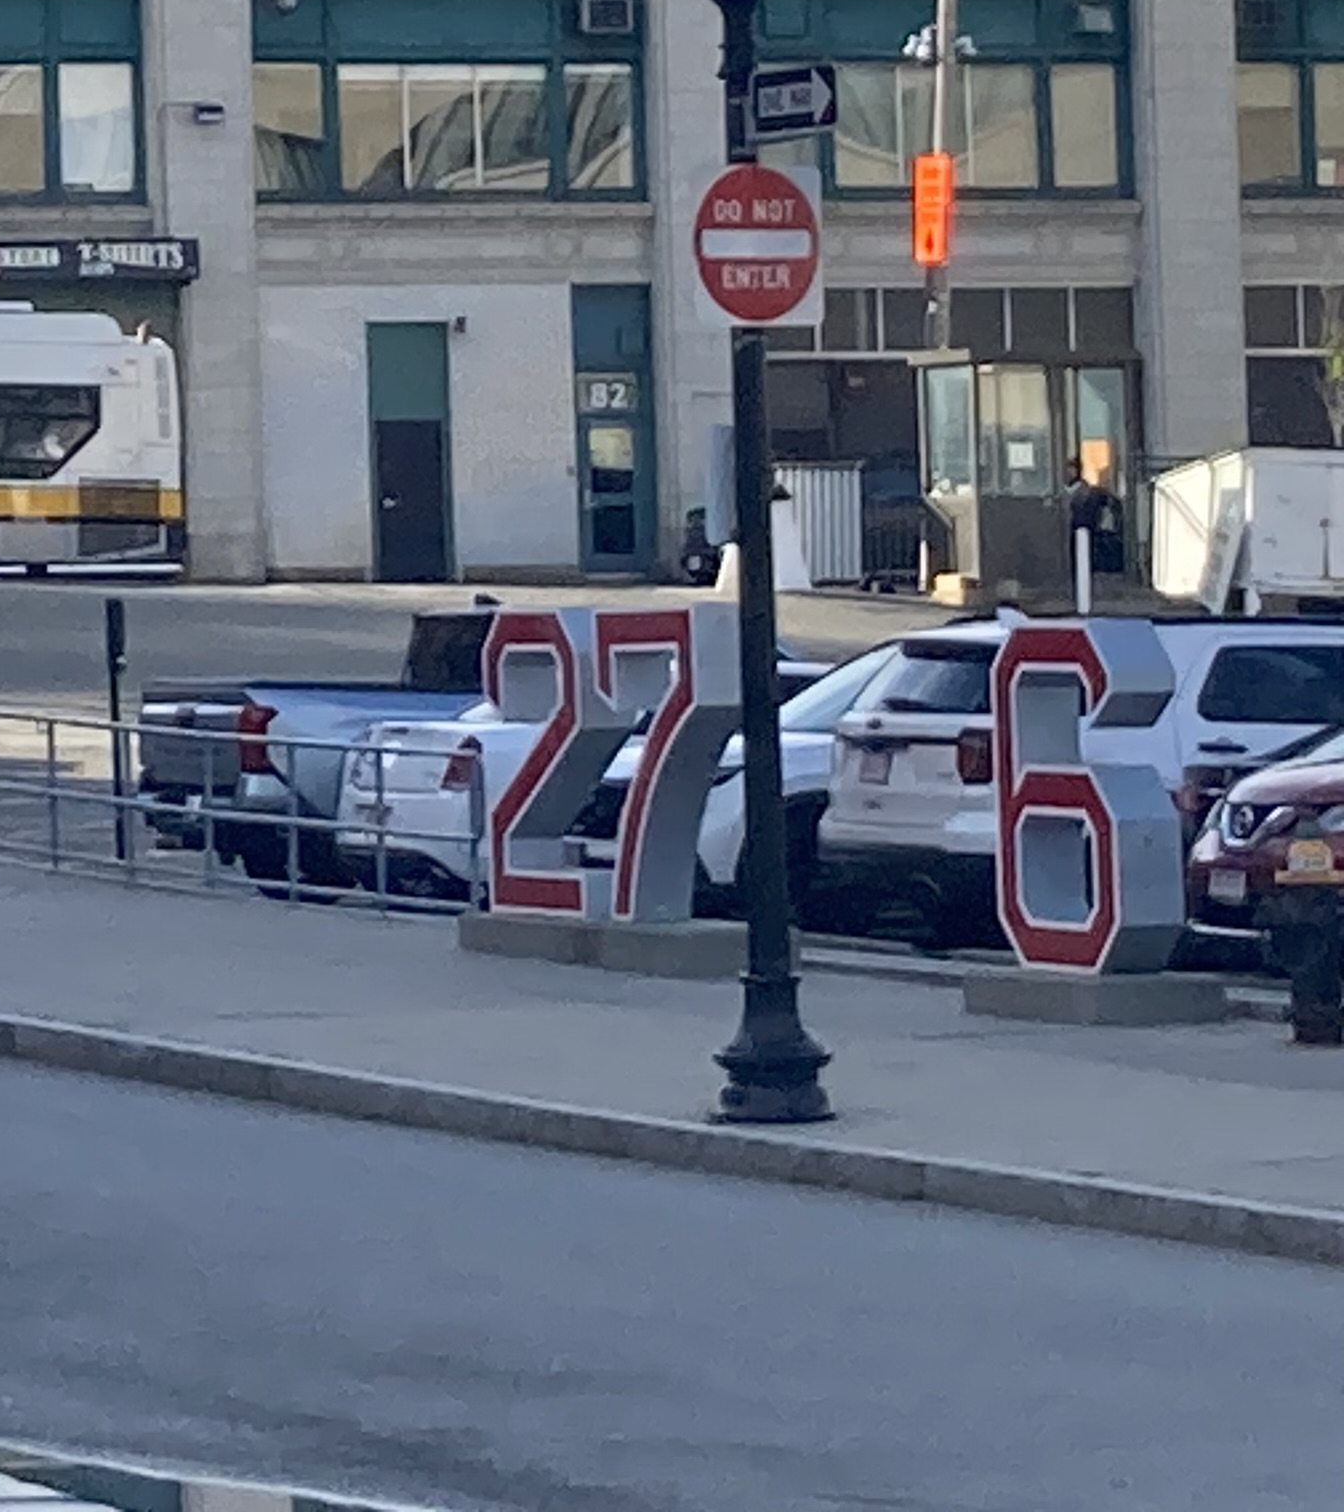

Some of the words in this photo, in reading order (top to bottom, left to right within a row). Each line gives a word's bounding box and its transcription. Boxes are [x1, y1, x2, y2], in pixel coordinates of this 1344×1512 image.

[713, 197, 743, 223] DO
[752, 197, 797, 223] NOT
[76, 242, 184, 270] T-SHIRTS
[721, 263, 792, 290] ENTER
[590, 381, 629, 409] 82
[482, 606, 698, 922] 27
[989, 618, 1121, 975] 6
